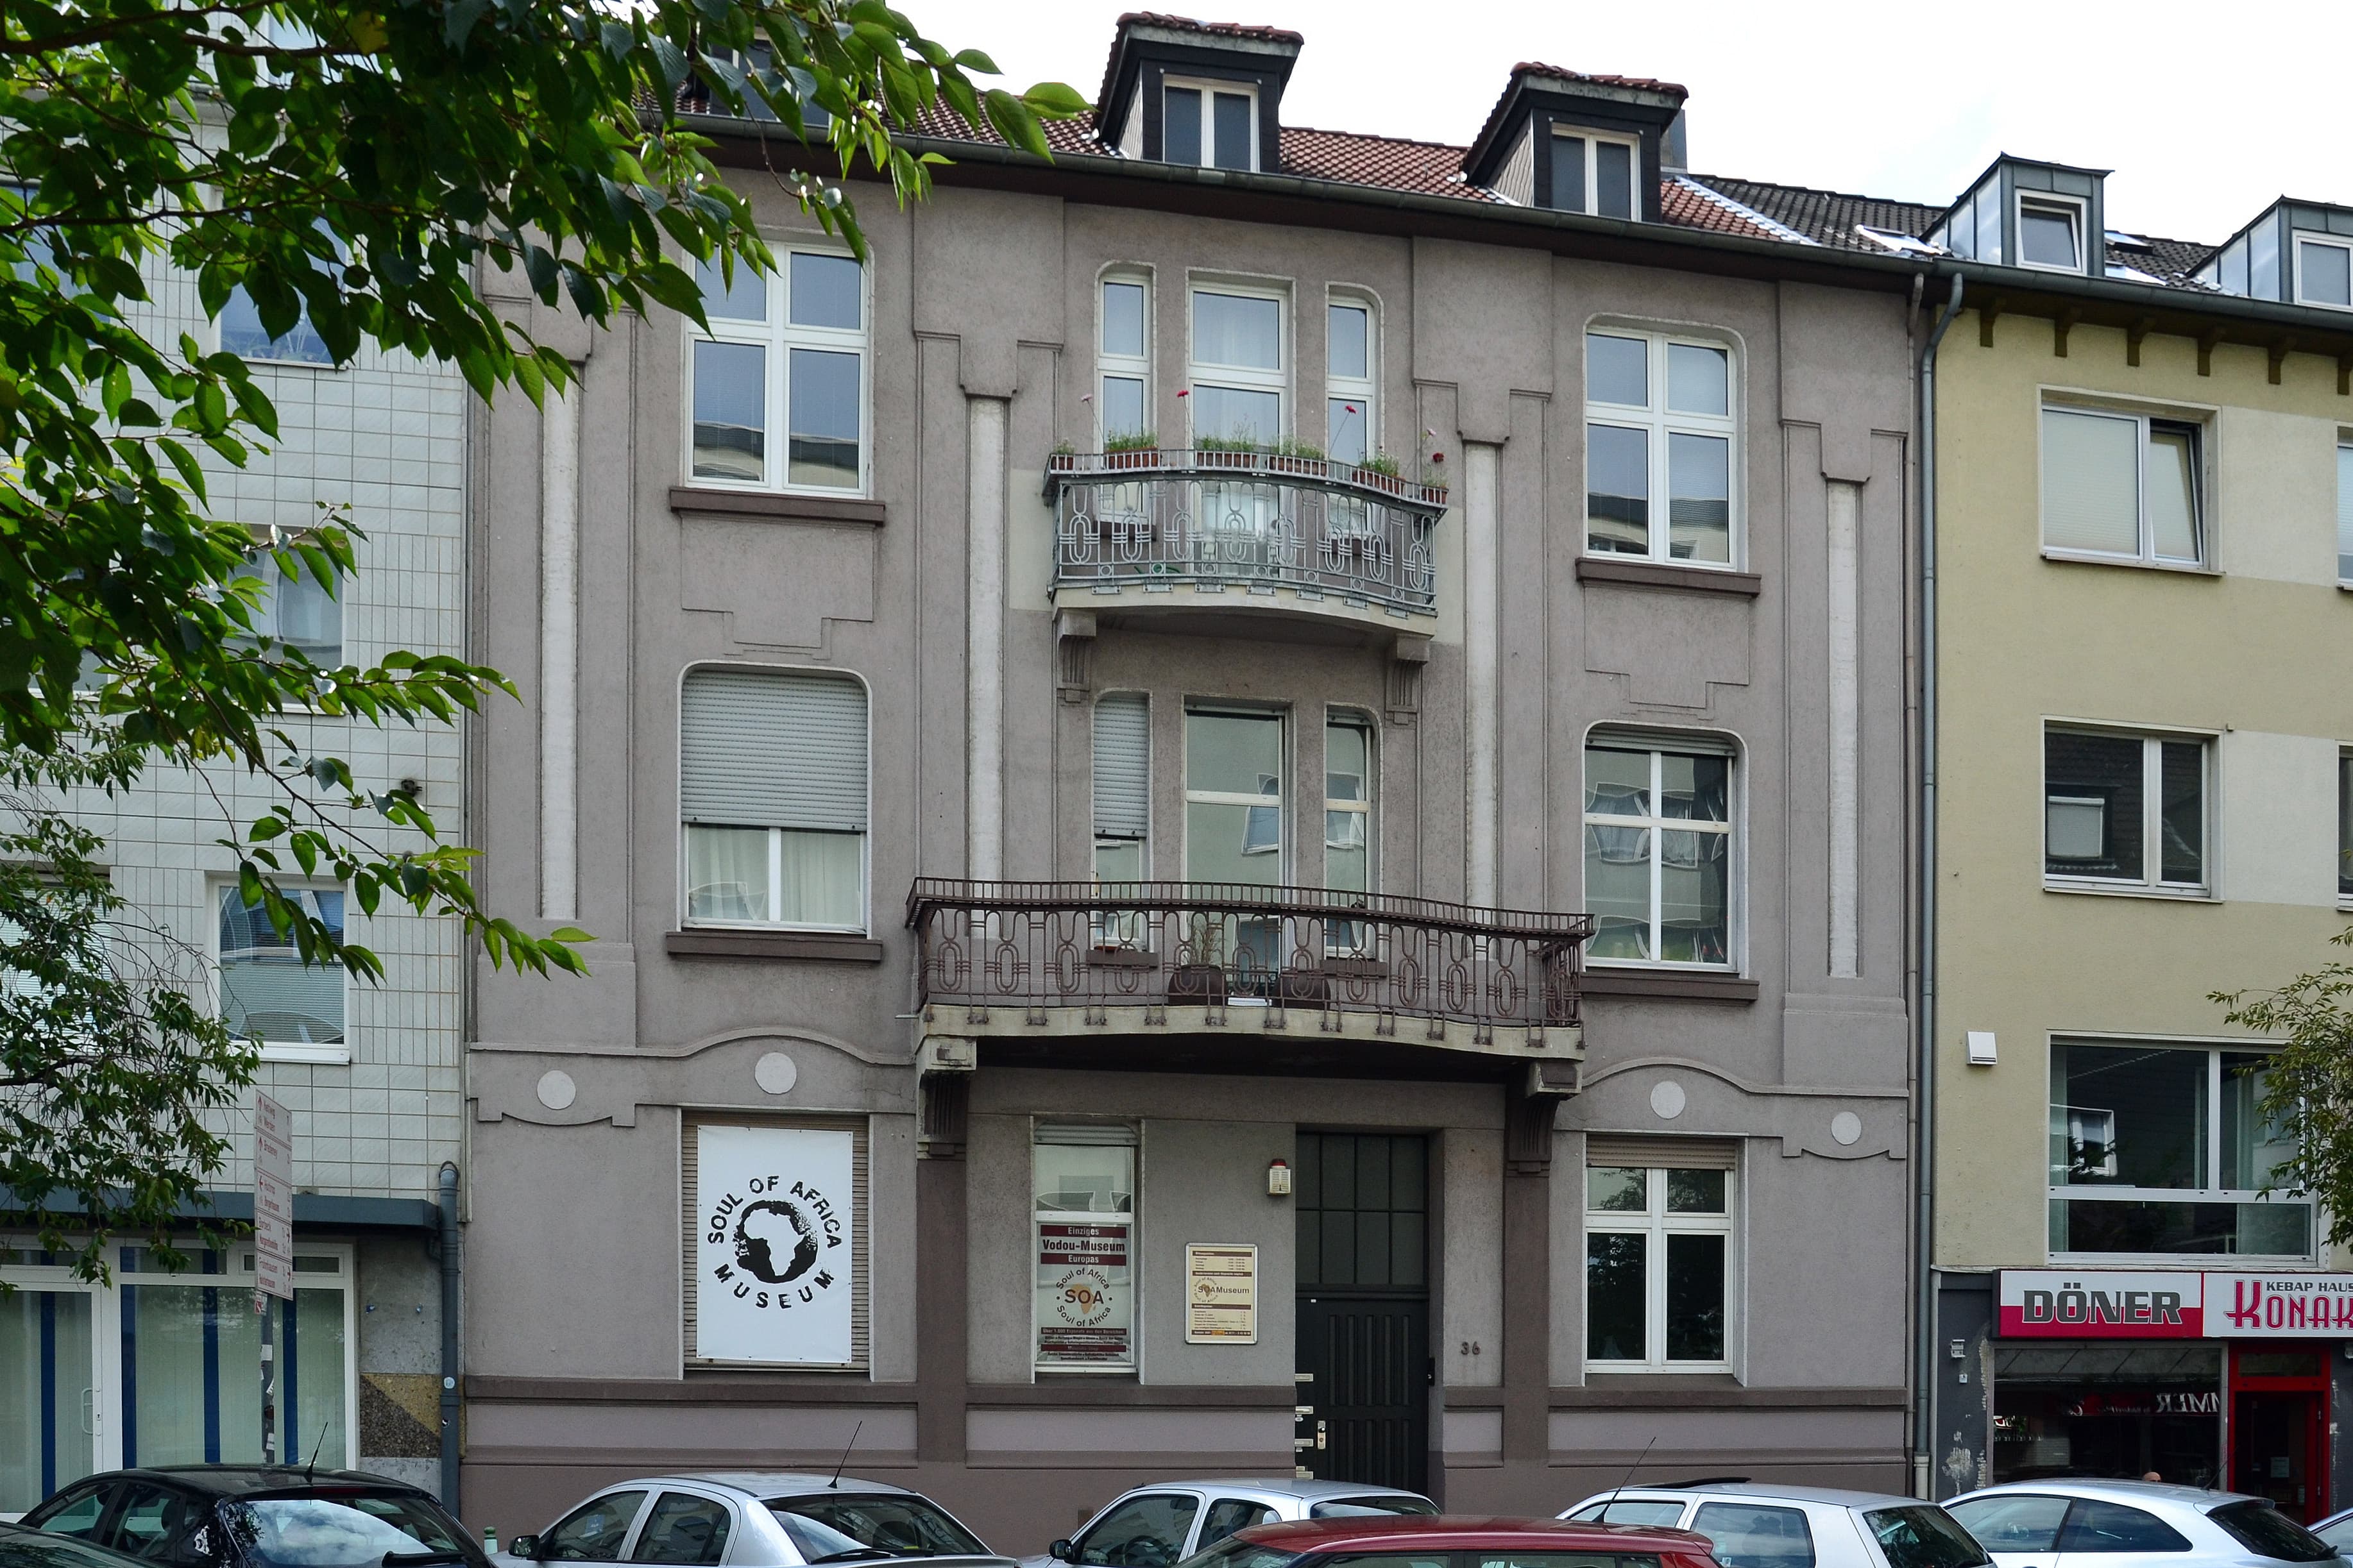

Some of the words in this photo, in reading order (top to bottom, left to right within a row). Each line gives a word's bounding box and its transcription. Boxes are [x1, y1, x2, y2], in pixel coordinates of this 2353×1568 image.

[708, 1193, 743, 1244] SOUL
[749, 1176, 779, 1194] OF
[790, 1181, 842, 1249] AFRICA
[1067, 1227, 1100, 1236] Einziges
[1042, 1239, 1125, 1252] Vodou-Museum
[1068, 1254, 1099, 1264] Europas
[1056, 1270, 1074, 1289] Soul
[1076, 1267, 1085, 1276] of
[1088, 1269, 1110, 1289] Africa
[714, 1263, 834, 1309] MUSEUM
[2266, 1281, 2313, 1292] KEBAP
[1064, 1289, 1104, 1304] SOA
[2023, 1282, 2182, 1324] DÖNER
[1057, 1305, 1075, 1324] Soul
[1089, 1307, 1111, 1326] Africa
[1461, 1341, 1481, 1355] 36
